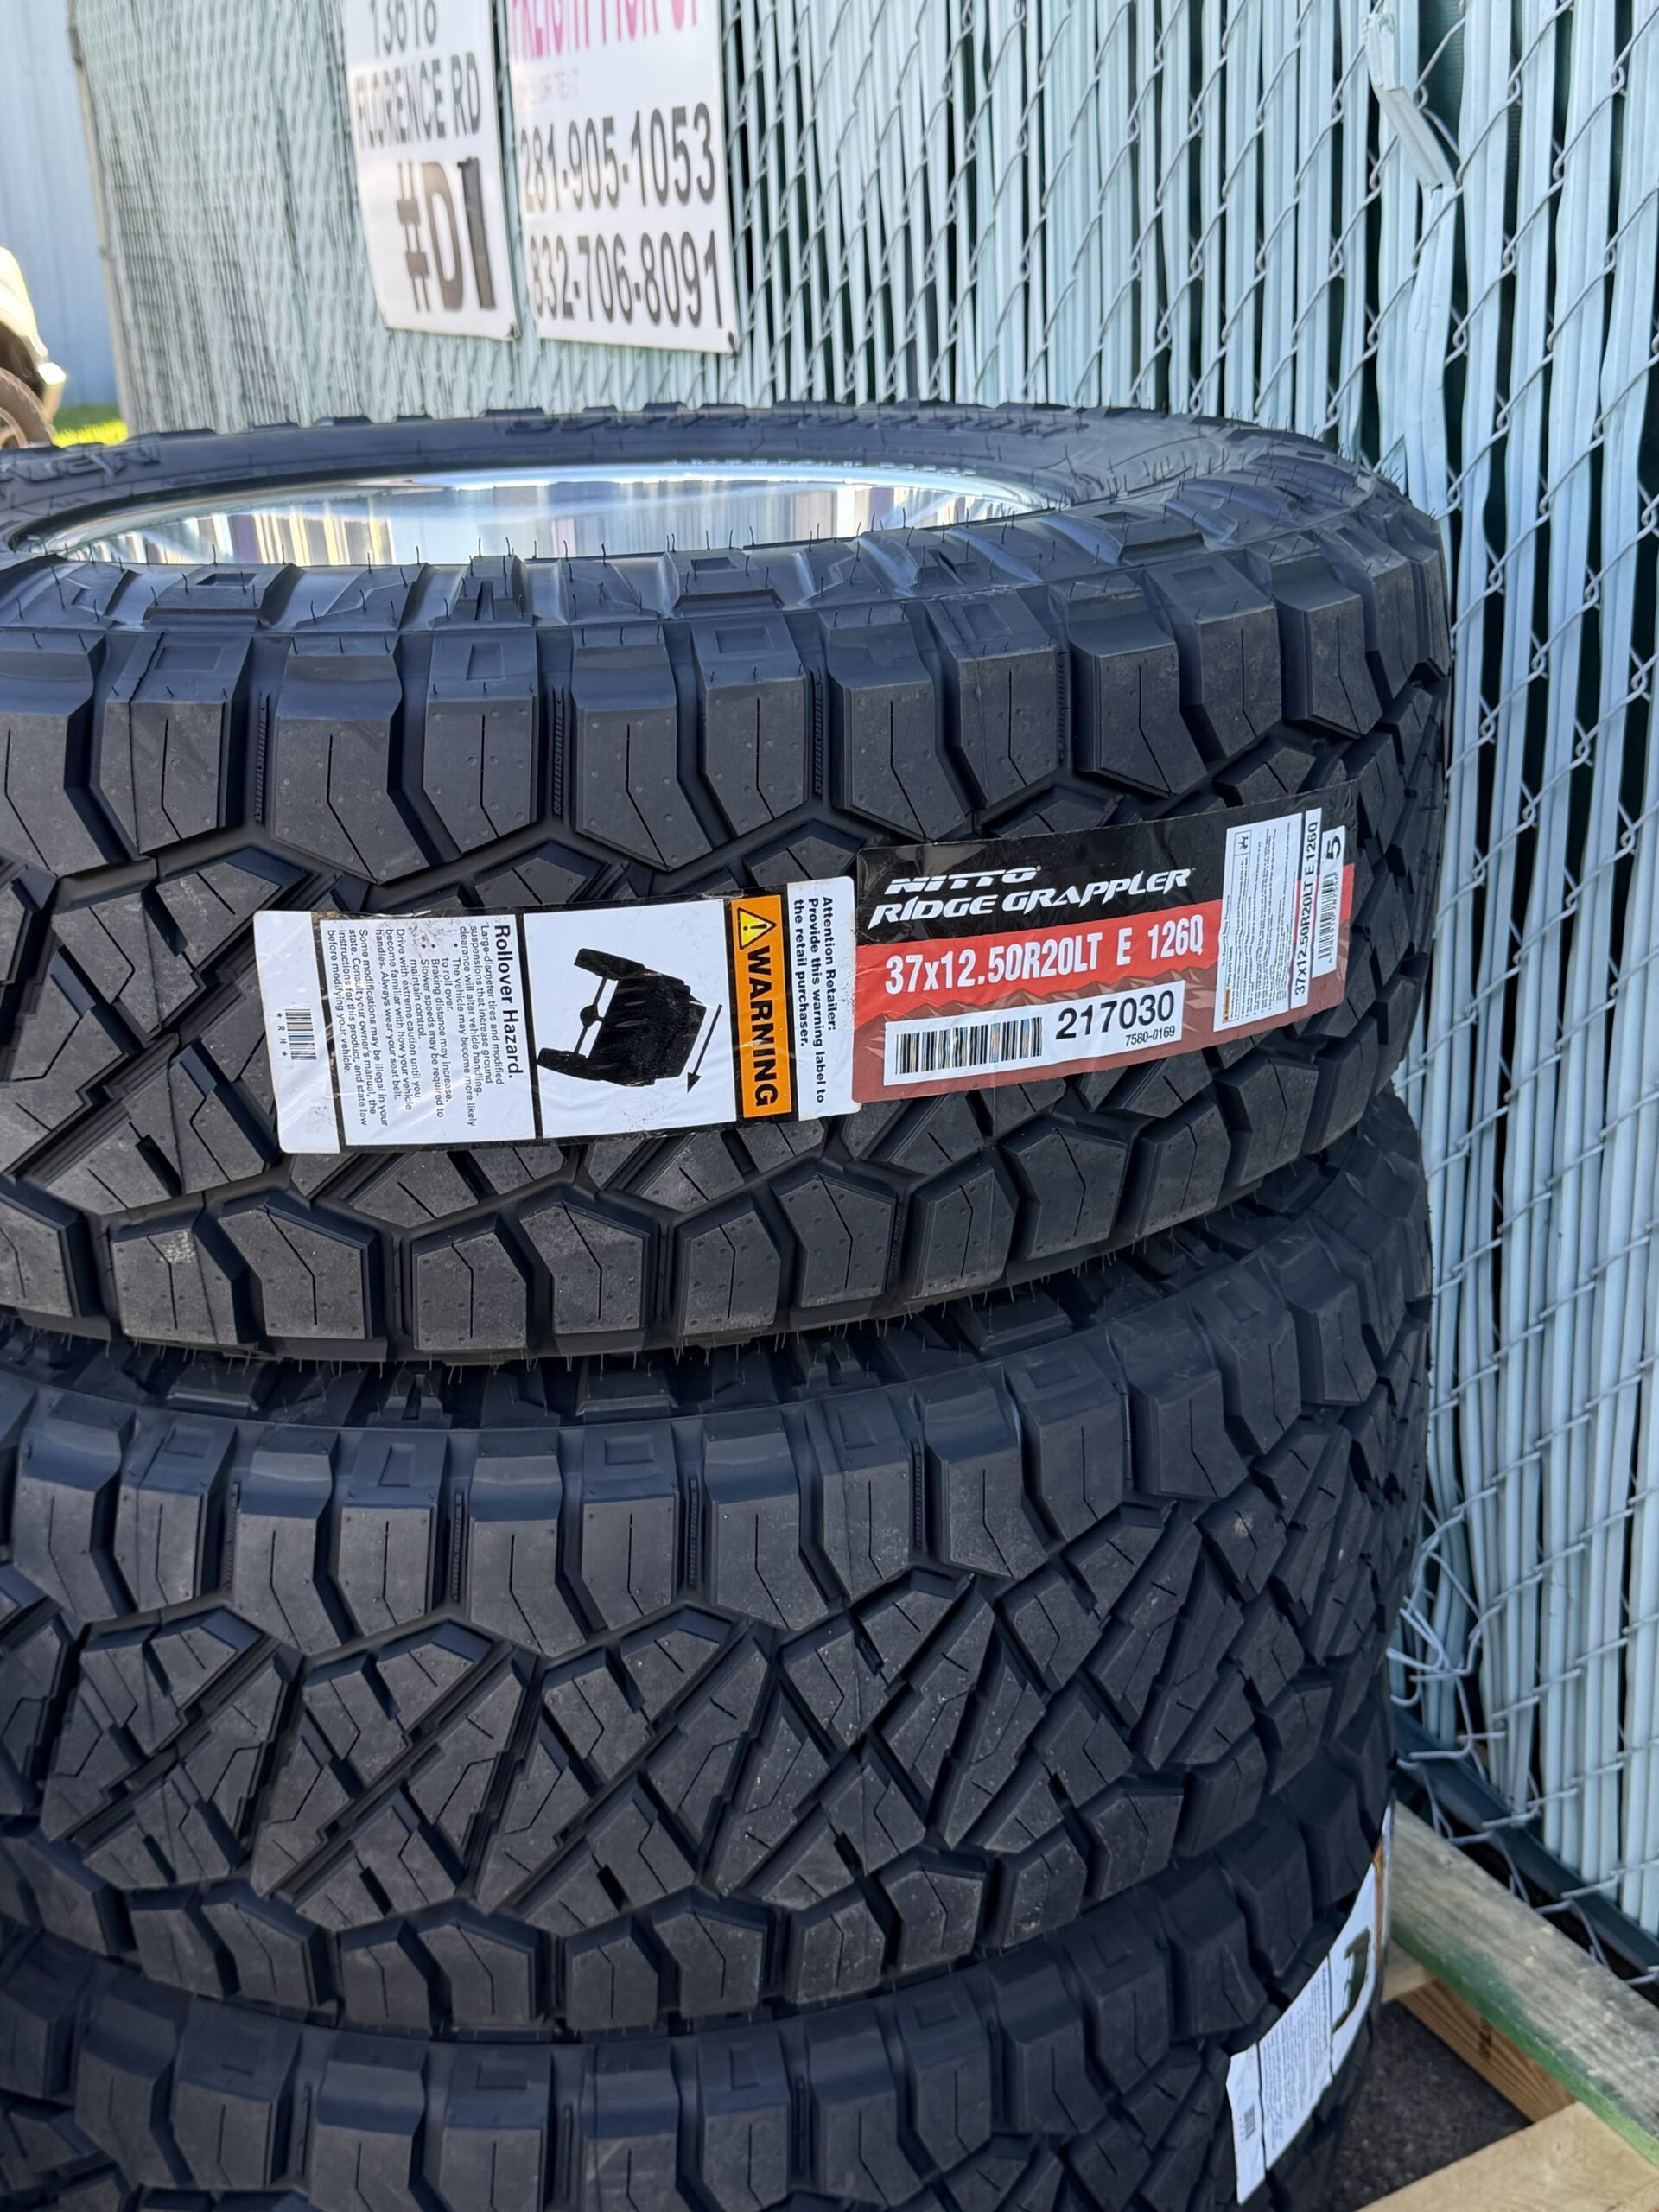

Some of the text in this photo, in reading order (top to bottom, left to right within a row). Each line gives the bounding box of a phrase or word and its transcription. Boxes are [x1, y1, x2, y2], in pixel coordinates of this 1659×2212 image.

[451, 51, 481, 137] RD
[520, 102, 715, 213] 281-905-1053
[529, 230, 723, 328] 832-706-8091
[868, 868, 1191, 930] RIDGE GRAPPLER
[884, 867, 1038, 895] NITTO
[1295, 821, 1319, 995] 37x12.50R20LT E 126Q
[1325, 836, 1341, 860] 5
[327, 930, 352, 1073] before modifying your vehicle.
[346, 929, 378, 1114] state. Consult your owner's manual, the
[375, 929, 402, 1099] handles. Always wear your seat belt.
[384, 929, 413, 1109] become familiar with how your vehicle
[396, 928, 421, 1097] Drive with extreme caution until you
[410, 959, 426, 1039] maintain control.
[442, 957, 453, 1011] to roll over.
[459, 925, 483, 1095] clearance will alter vehicle handling.
[468, 925, 493, 1083] suspensions that increase ground
[487, 1000, 497, 1020] tires
[494, 925, 523, 1077] Rollover Hazard.
[747, 944, 778, 1106] WARNING
[793, 899, 809, 1046] the retail purchaser.
[808, 897, 826, 1103] Provide this warning label to
[822, 896, 837, 1030] Attention Retailer:
[885, 914, 1204, 995] 37x12.50R20LT E 126Q
[1055, 990, 1175, 1040] 217030
[337, 929, 367, 1126] instructions for this product, and state law
[359, 929, 387, 1126] Some modifications may be illegal in your
[420, 958, 443, 1117] Slower speeds may be required to
[430, 958, 452, 1102] Braking distance may increase.
[452, 957, 476, 1126] The vehicle may become more likely
[490, 1023, 500, 1040] and
[493, 1043, 504, 1084] modified
[1125, 1027, 1176, 1046] 7580-0169
